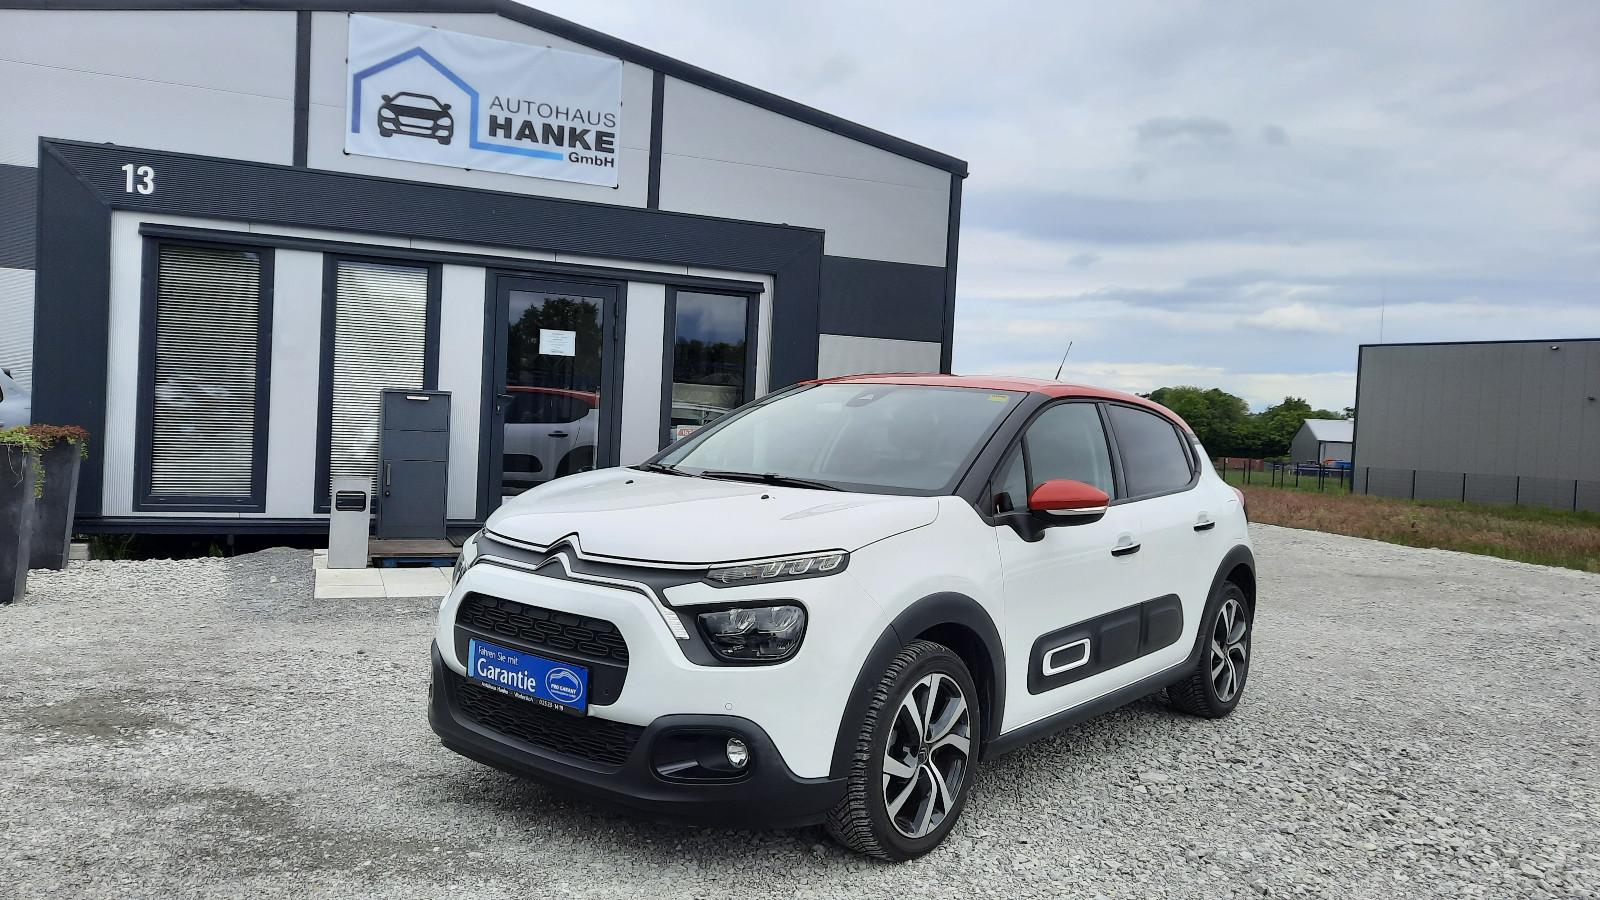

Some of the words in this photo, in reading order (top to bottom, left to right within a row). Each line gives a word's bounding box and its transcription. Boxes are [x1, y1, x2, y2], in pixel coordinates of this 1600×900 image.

[489, 95, 616, 128] AUTOHAUS
[488, 114, 616, 154] HANKE
[568, 152, 615, 168] GmbH
[121, 163, 154, 195] 13
[478, 645, 496, 659] Fahren
[497, 652, 506, 662] Sie
[507, 656, 518, 666] mit
[477, 658, 536, 693] Garantie
